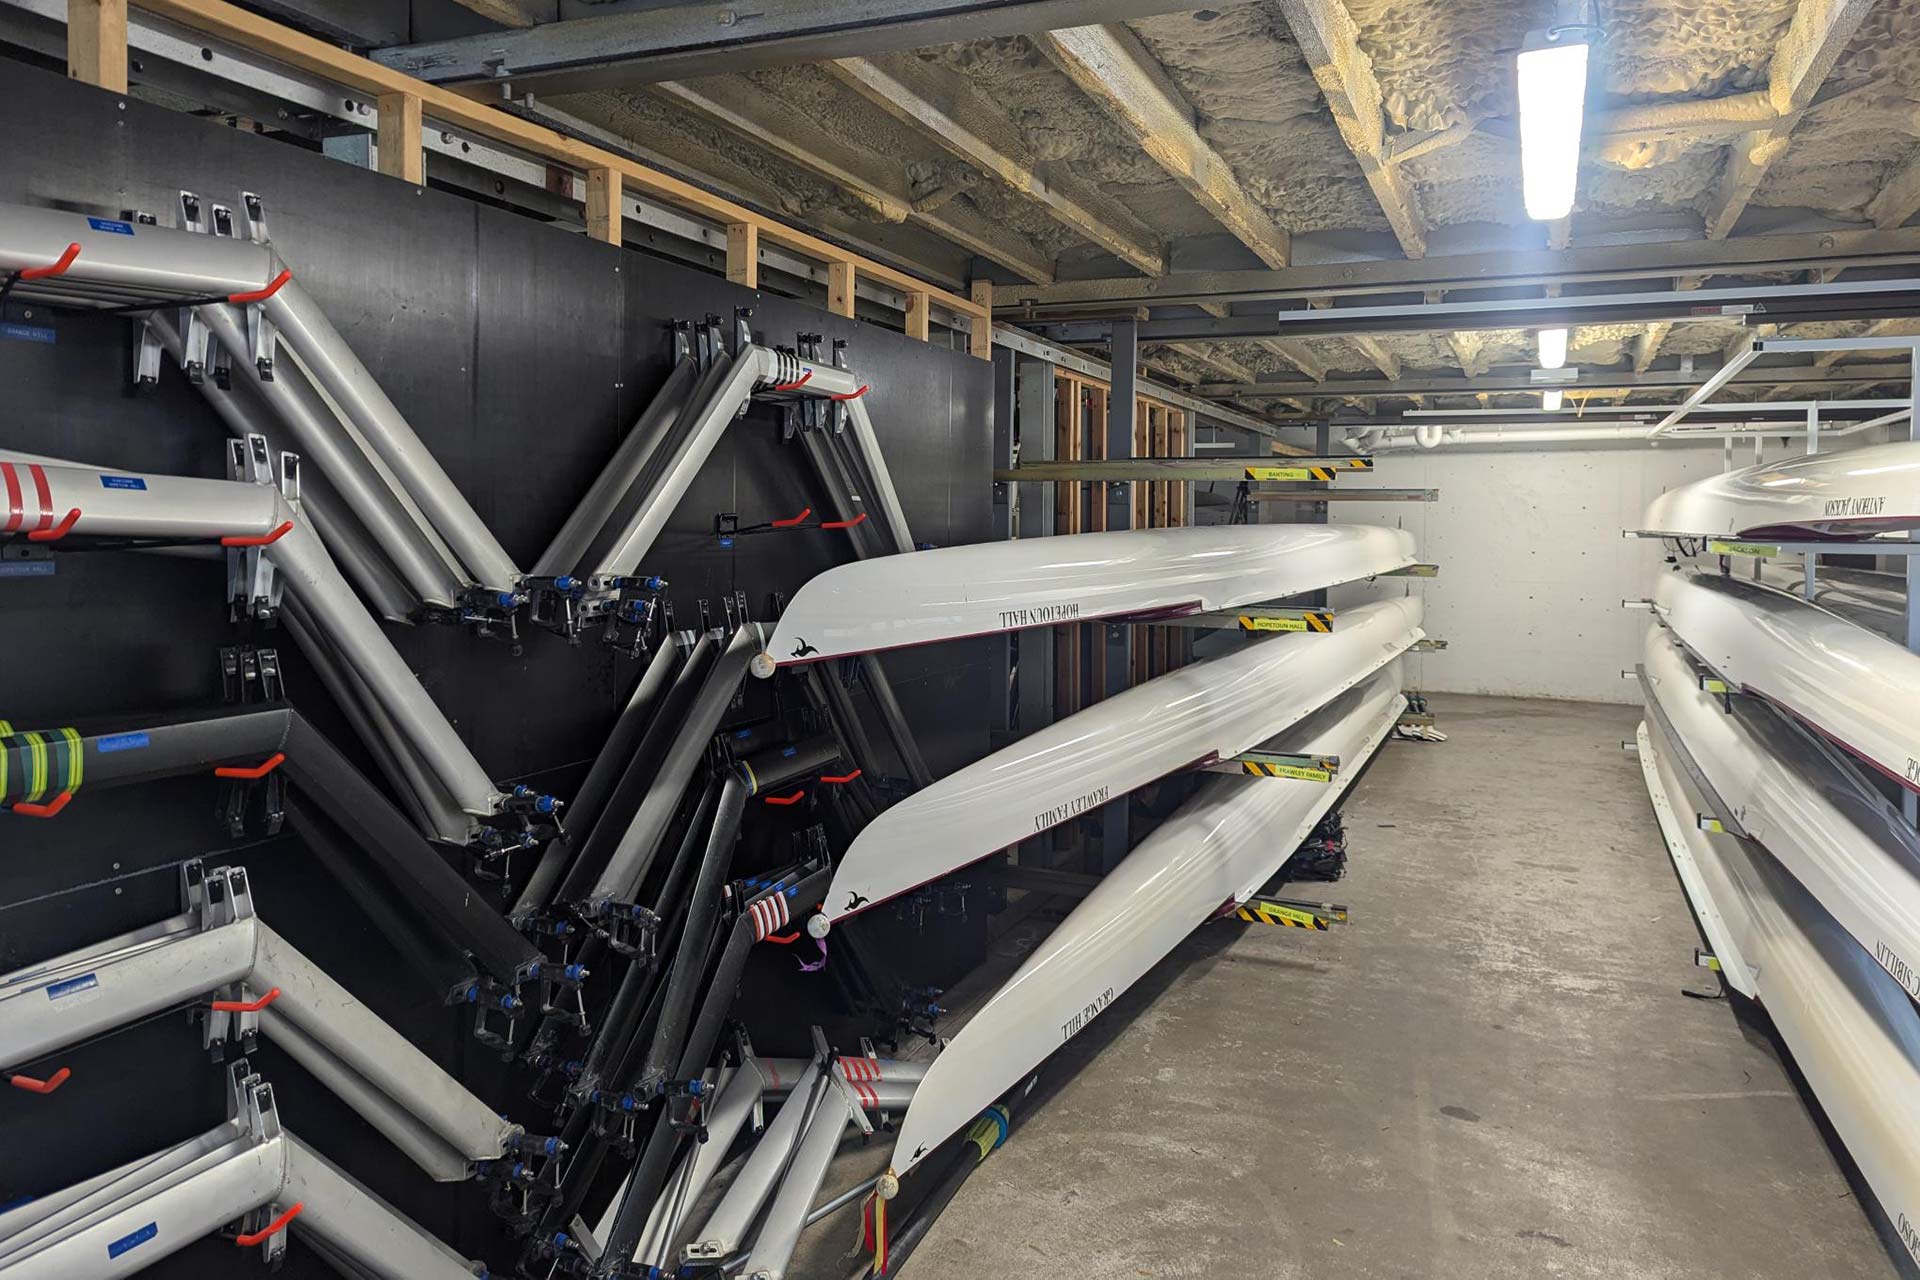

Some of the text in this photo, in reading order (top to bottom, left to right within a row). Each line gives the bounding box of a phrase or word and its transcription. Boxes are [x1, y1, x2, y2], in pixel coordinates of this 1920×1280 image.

[1825, 496, 1887, 517] ANTHONY JACKSON
[998, 603, 1079, 628] HOPETOUN HALL
[1257, 621, 1289, 630] HOPETOUN
[1280, 767, 1327, 780] FRAWLEY FAMILY
[1033, 785, 1109, 832] FRAWLEY FAMILY
[1061, 987, 1114, 1040] GRANGE HILL
